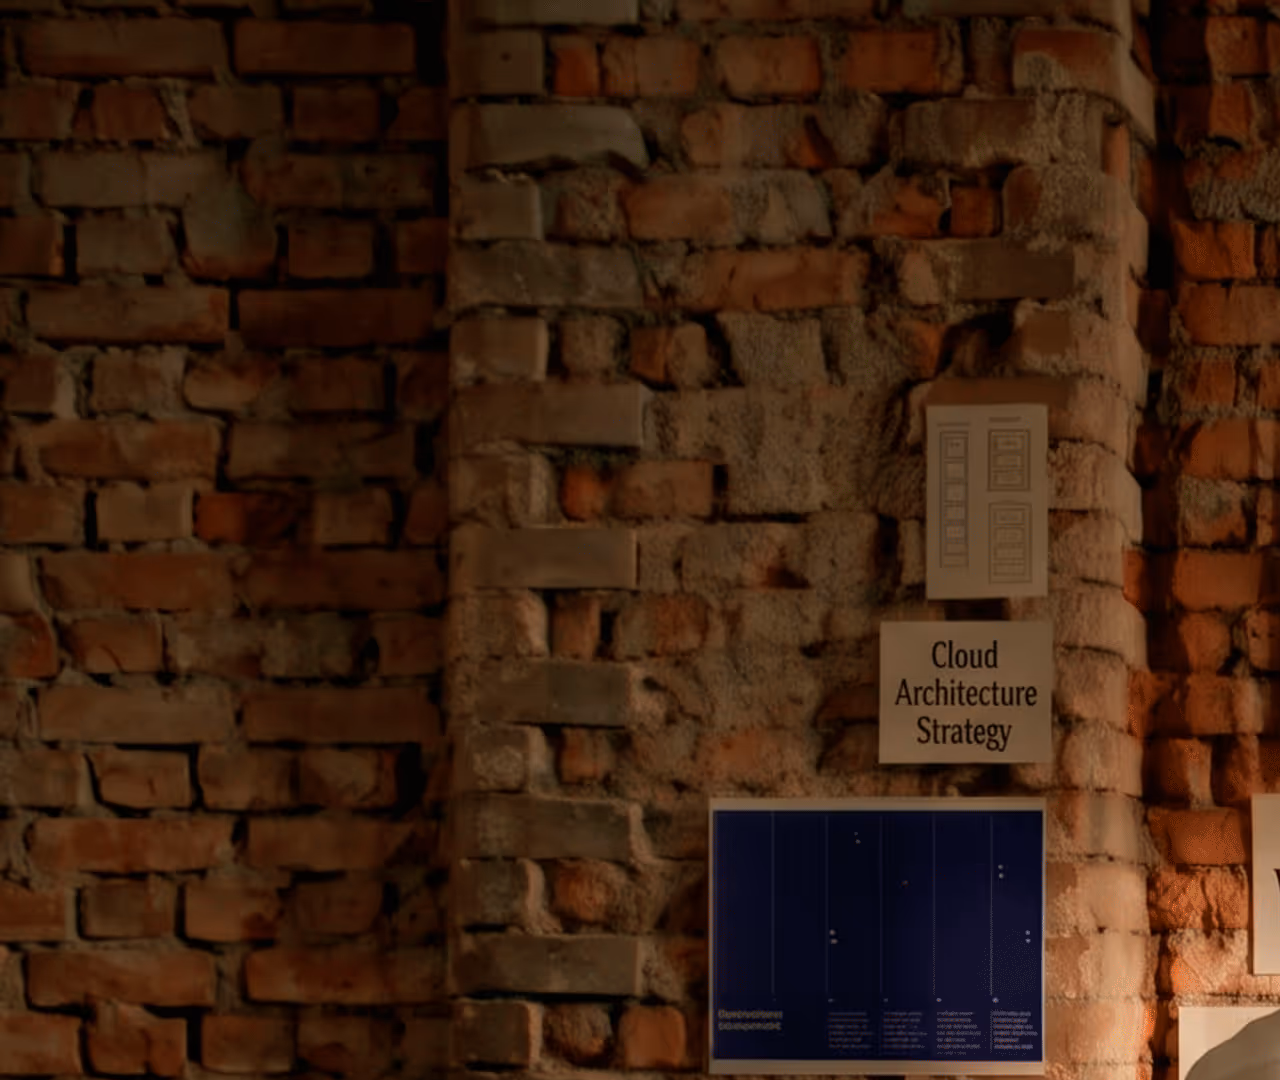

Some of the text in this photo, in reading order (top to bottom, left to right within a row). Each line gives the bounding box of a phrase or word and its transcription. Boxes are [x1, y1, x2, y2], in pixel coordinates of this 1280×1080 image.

[931, 639, 998, 669] Cloud
[894, 677, 1038, 707] Architecture
[916, 715, 1013, 753] Strategy
